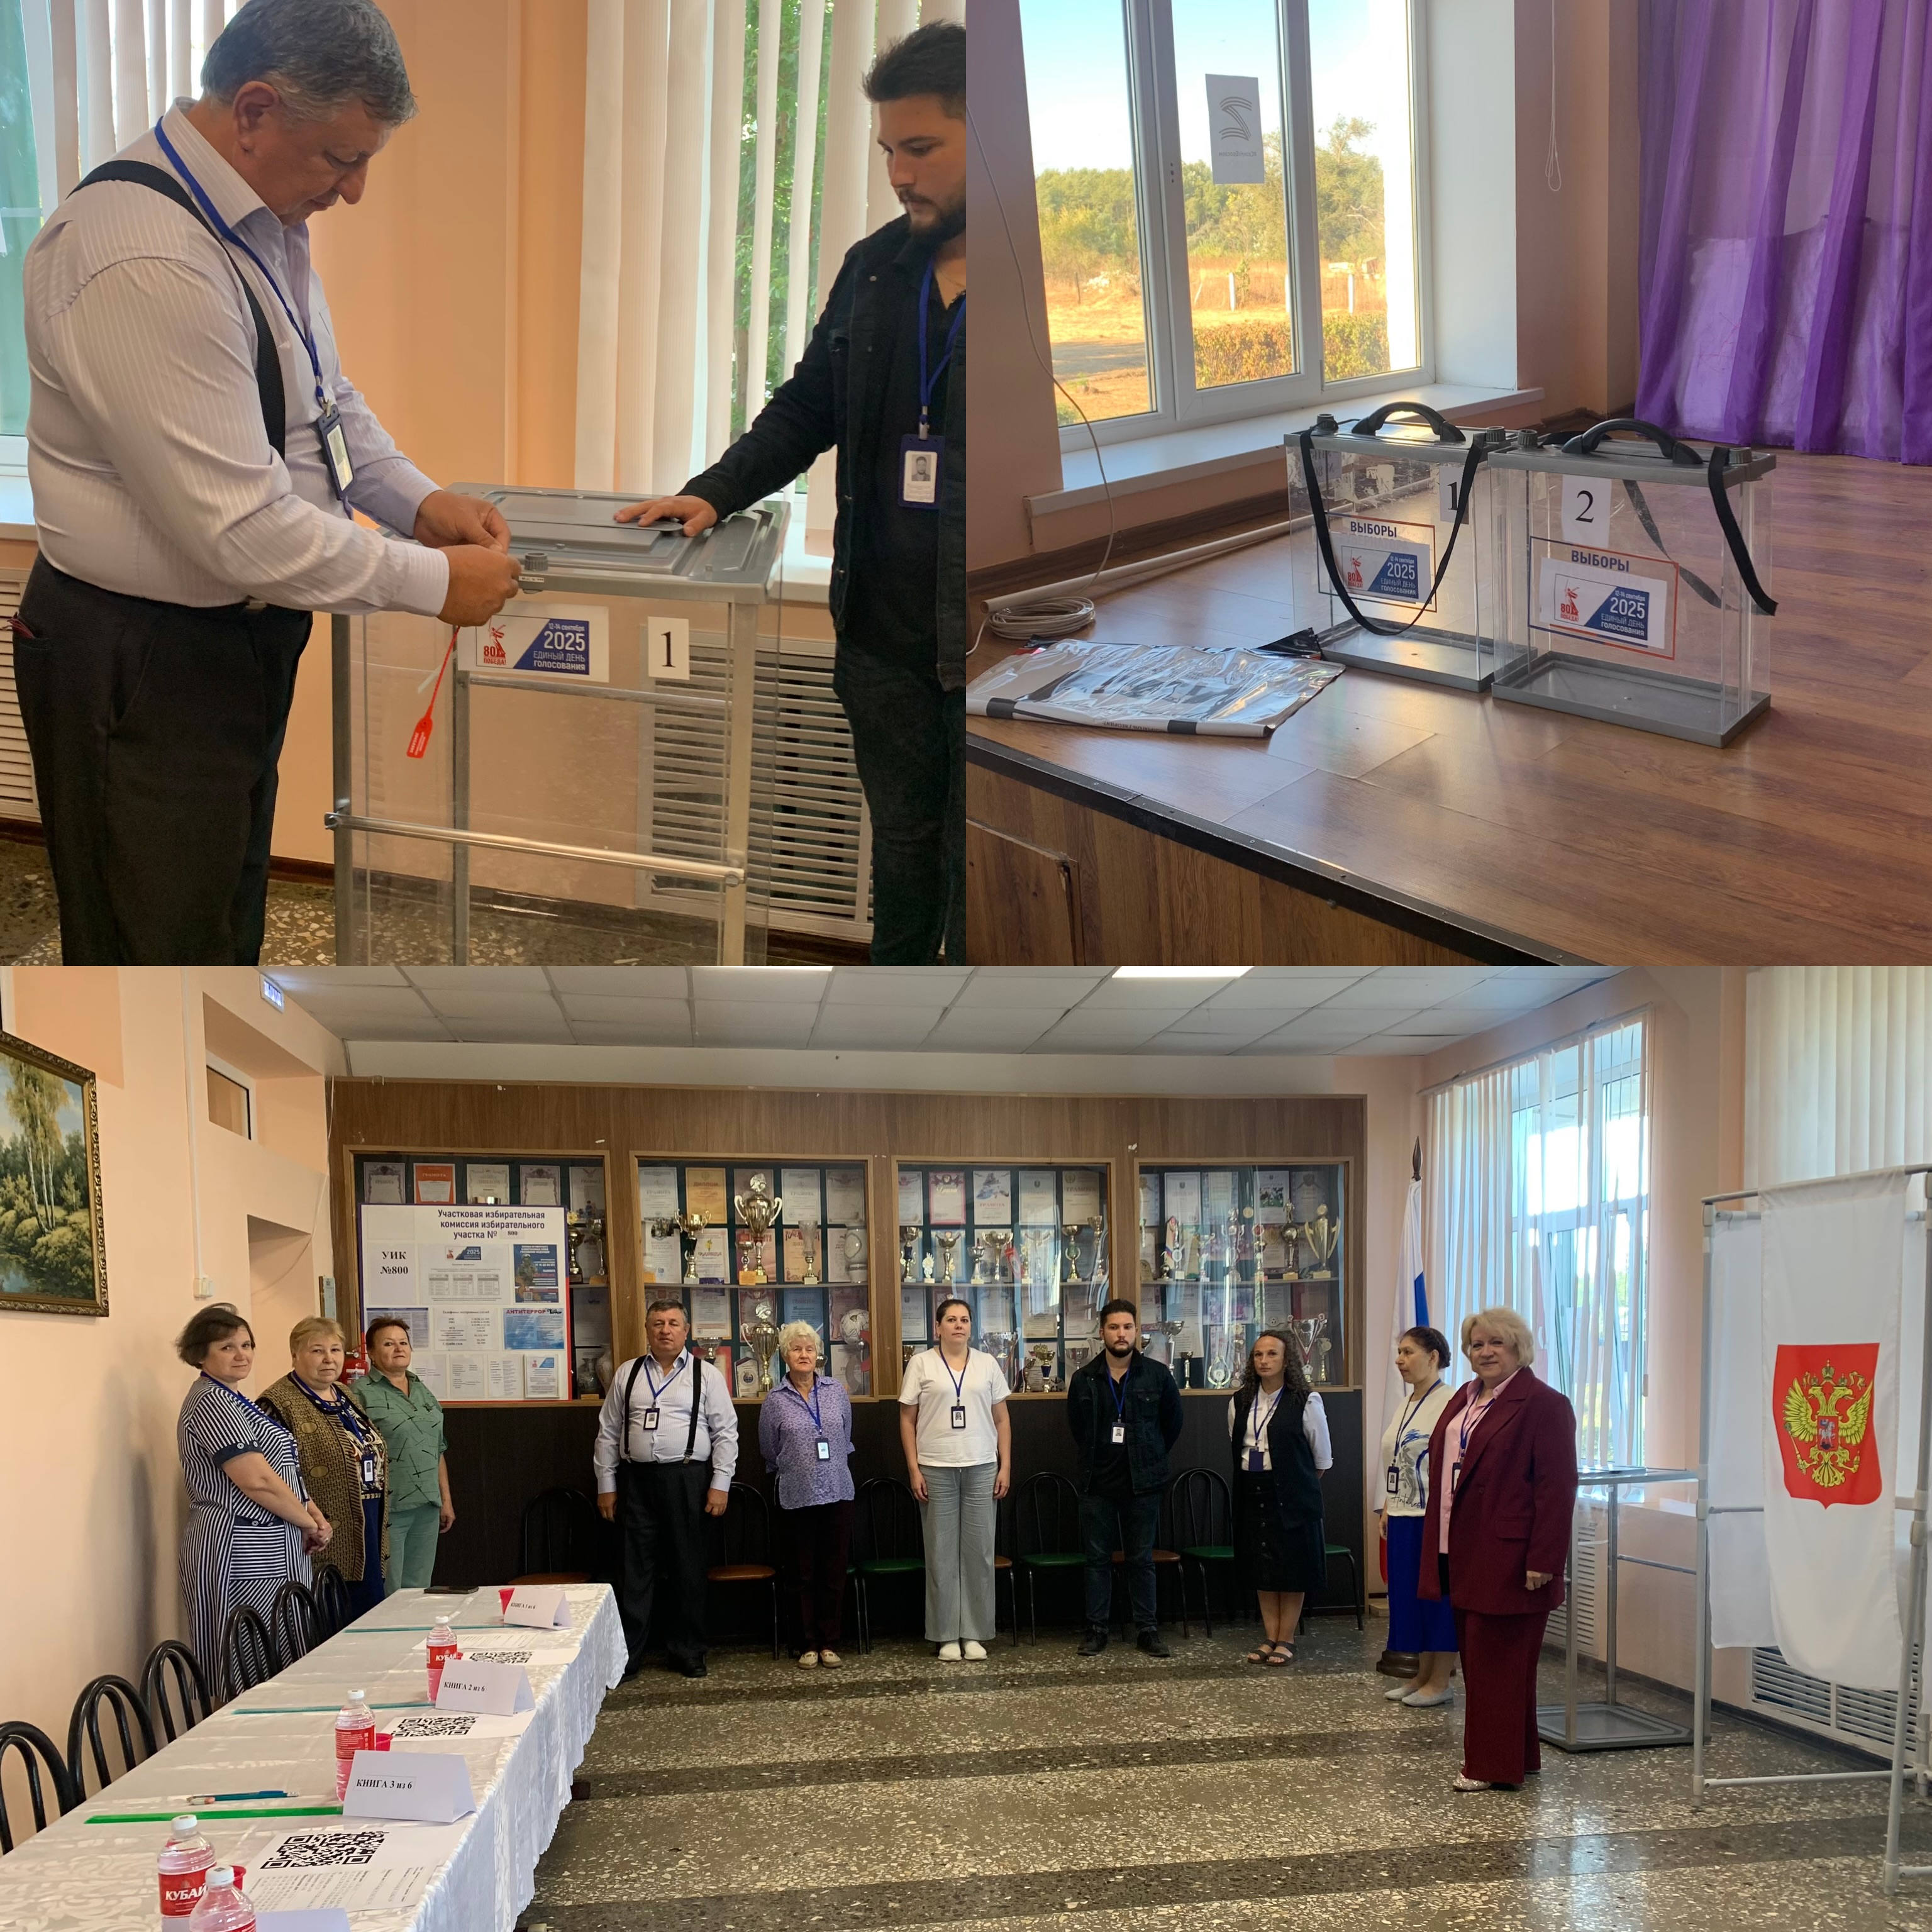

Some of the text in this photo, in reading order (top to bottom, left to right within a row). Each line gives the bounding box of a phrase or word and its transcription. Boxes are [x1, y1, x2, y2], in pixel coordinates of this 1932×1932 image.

[1575, 490, 1595, 523] 2
[1350, 521, 1397, 538] ВЫБОРЫ
[1571, 550, 1629, 572] ВЫБОРЫ
[1387, 562, 1416, 580] 2025
[1380, 577, 1416, 589] ЕДИНЫЙ ДЕНЬ
[1560, 603, 1570, 614] 80
[1610, 597, 1645, 619] 2025
[1601, 613, 1645, 629] ЕДИНЫЙ ДЕНЬ
[543, 630, 586, 652] 2025
[484, 645, 496, 657] 80
[660, 631, 676, 668] 1
[533, 650, 586, 662] ЕДИНЫЙ ДЕНЬ
[438, 1209, 545, 1220] Участковая избирательная
[481, 1220, 545, 1230] избирательного
[453, 1231, 485, 1240] участка
[487, 1230, 497, 1238] №
[382, 1251, 407, 1260] УИК
[380, 1266, 409, 1274] №800
[444, 1682, 467, 1690] КНИГА
[356, 1779, 387, 1788] КНИГА
[389, 1780, 395, 1789] 3
[408, 1781, 413, 1789] 6
